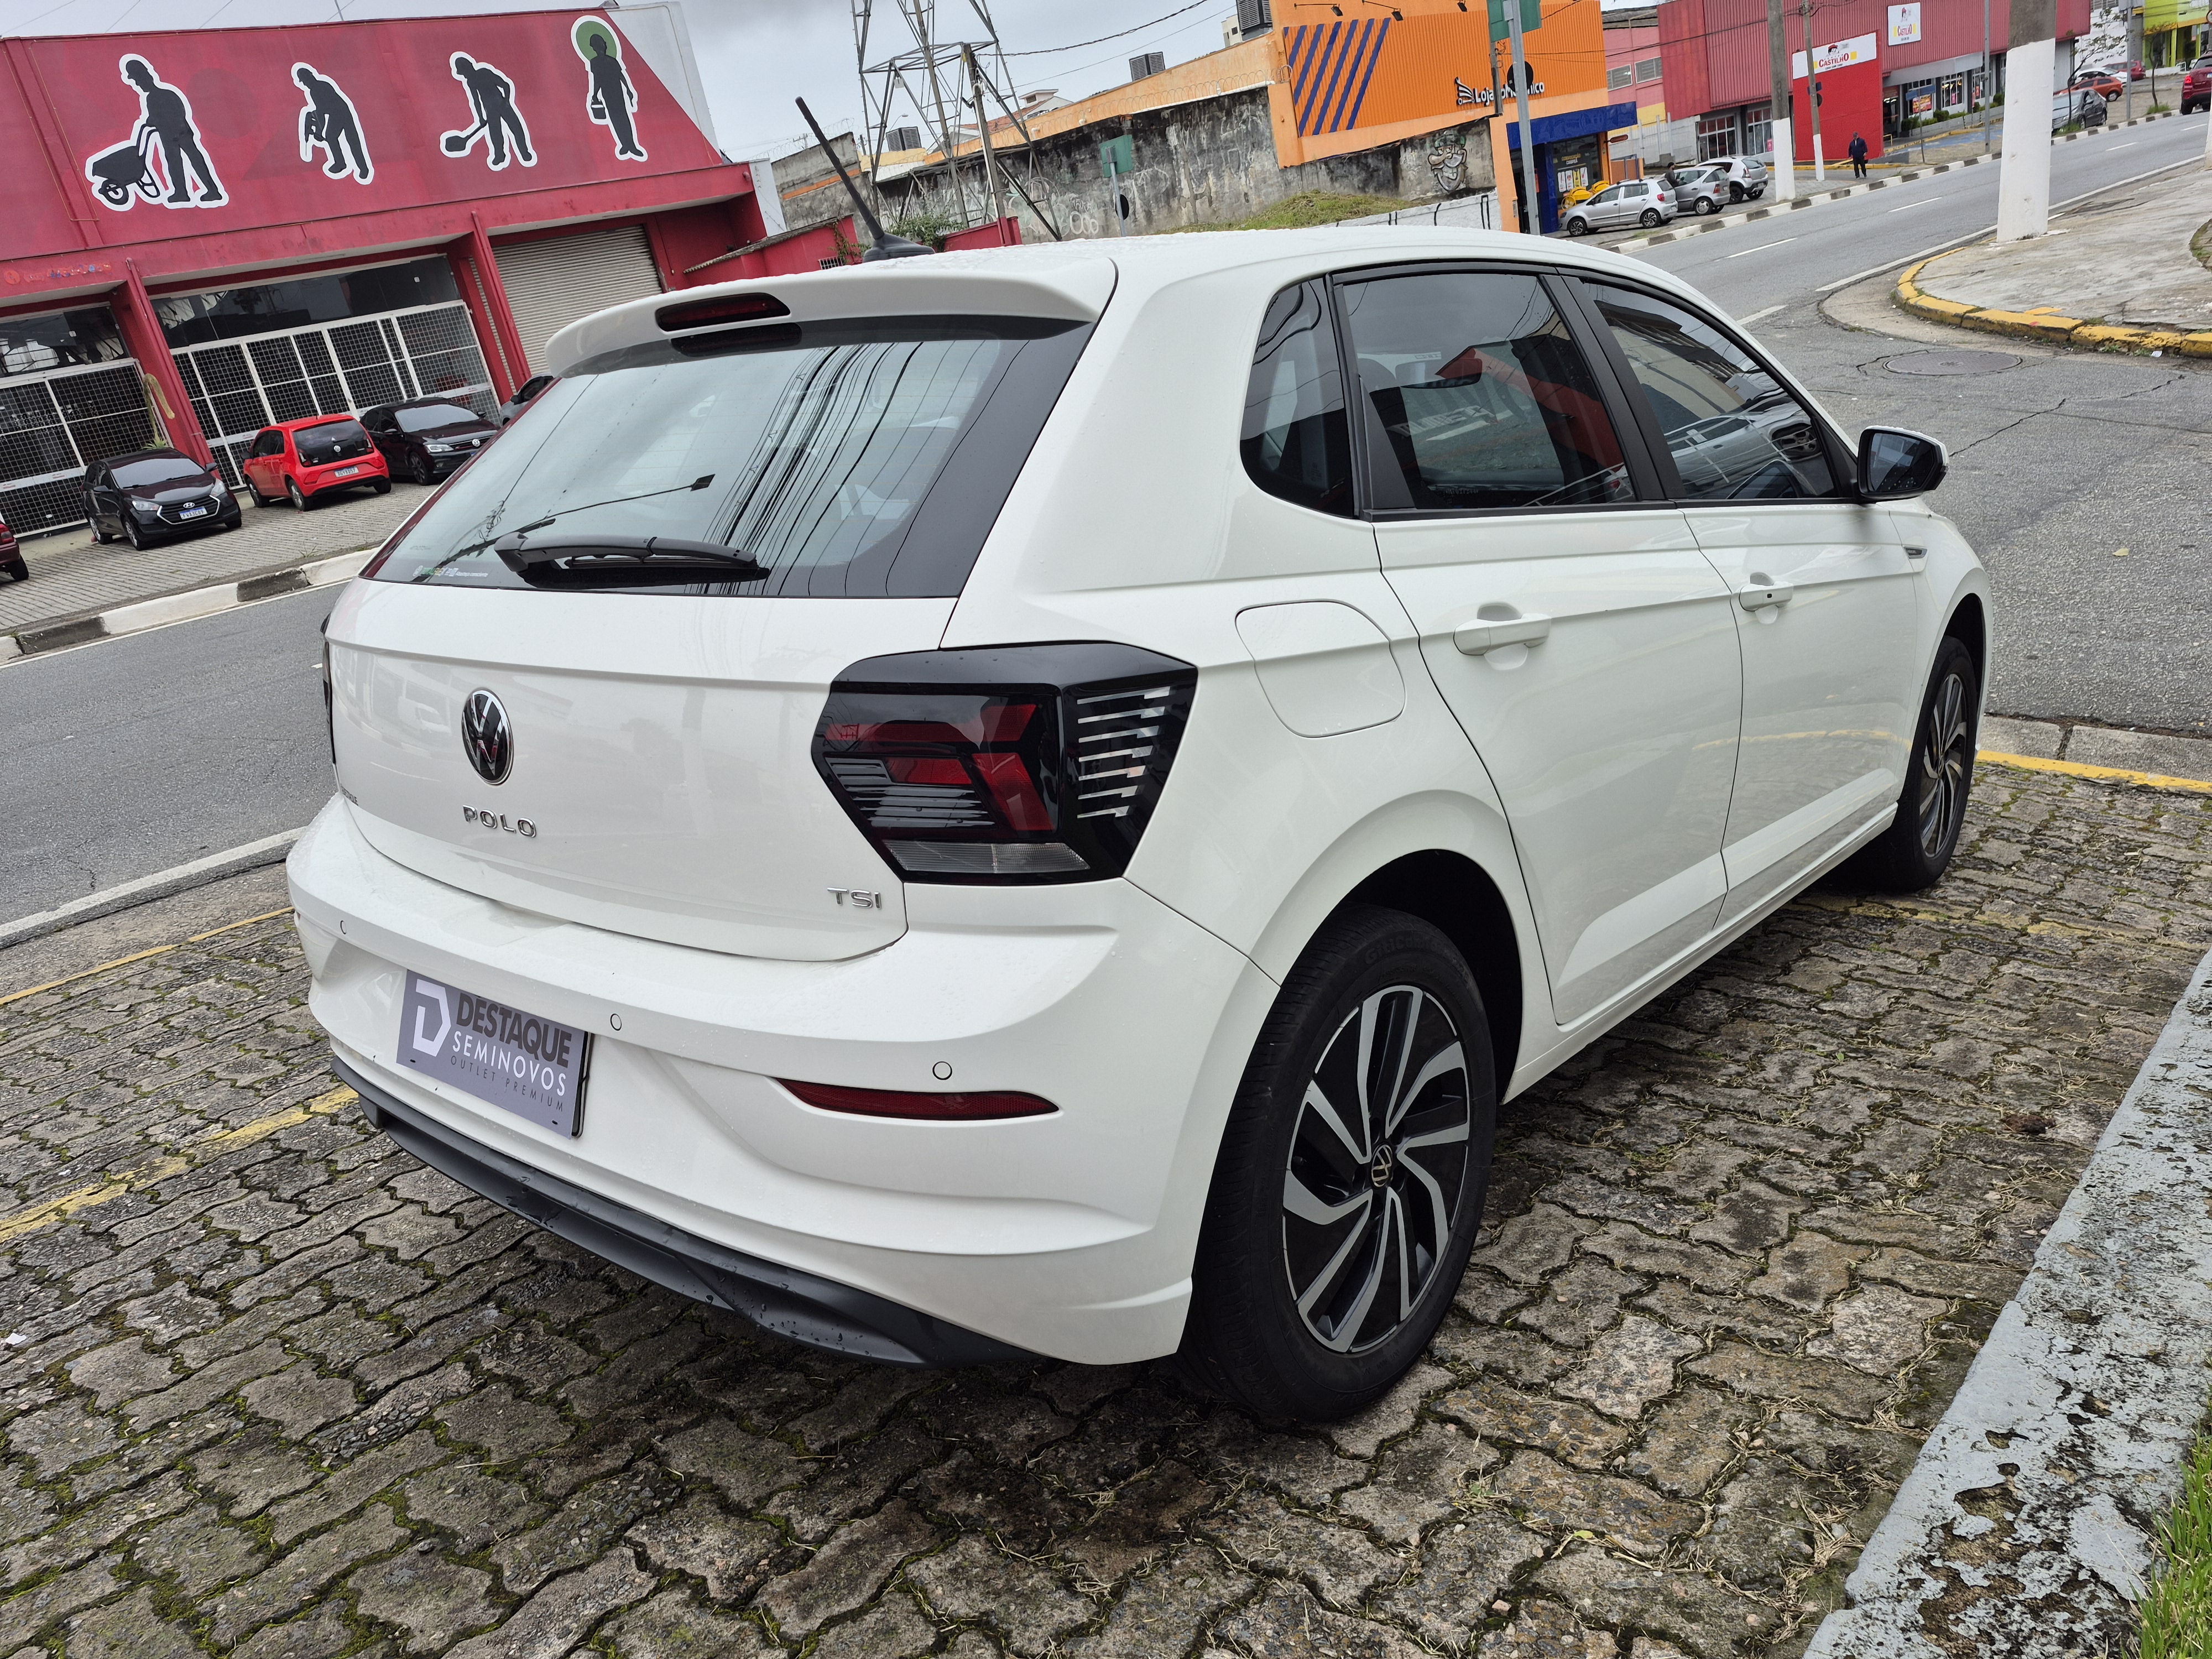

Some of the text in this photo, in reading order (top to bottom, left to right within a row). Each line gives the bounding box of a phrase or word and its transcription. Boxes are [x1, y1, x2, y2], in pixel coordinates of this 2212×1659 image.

[1819, 53, 1849, 68] CASTILHO
[462, 805, 537, 838] POLO
[827, 887, 882, 910] TSI
[456, 993, 572, 1068] DESTAQUE
[450, 1055, 563, 1112] OUTLET PREMIUM
[452, 1030, 566, 1096] SEMINOVOS
